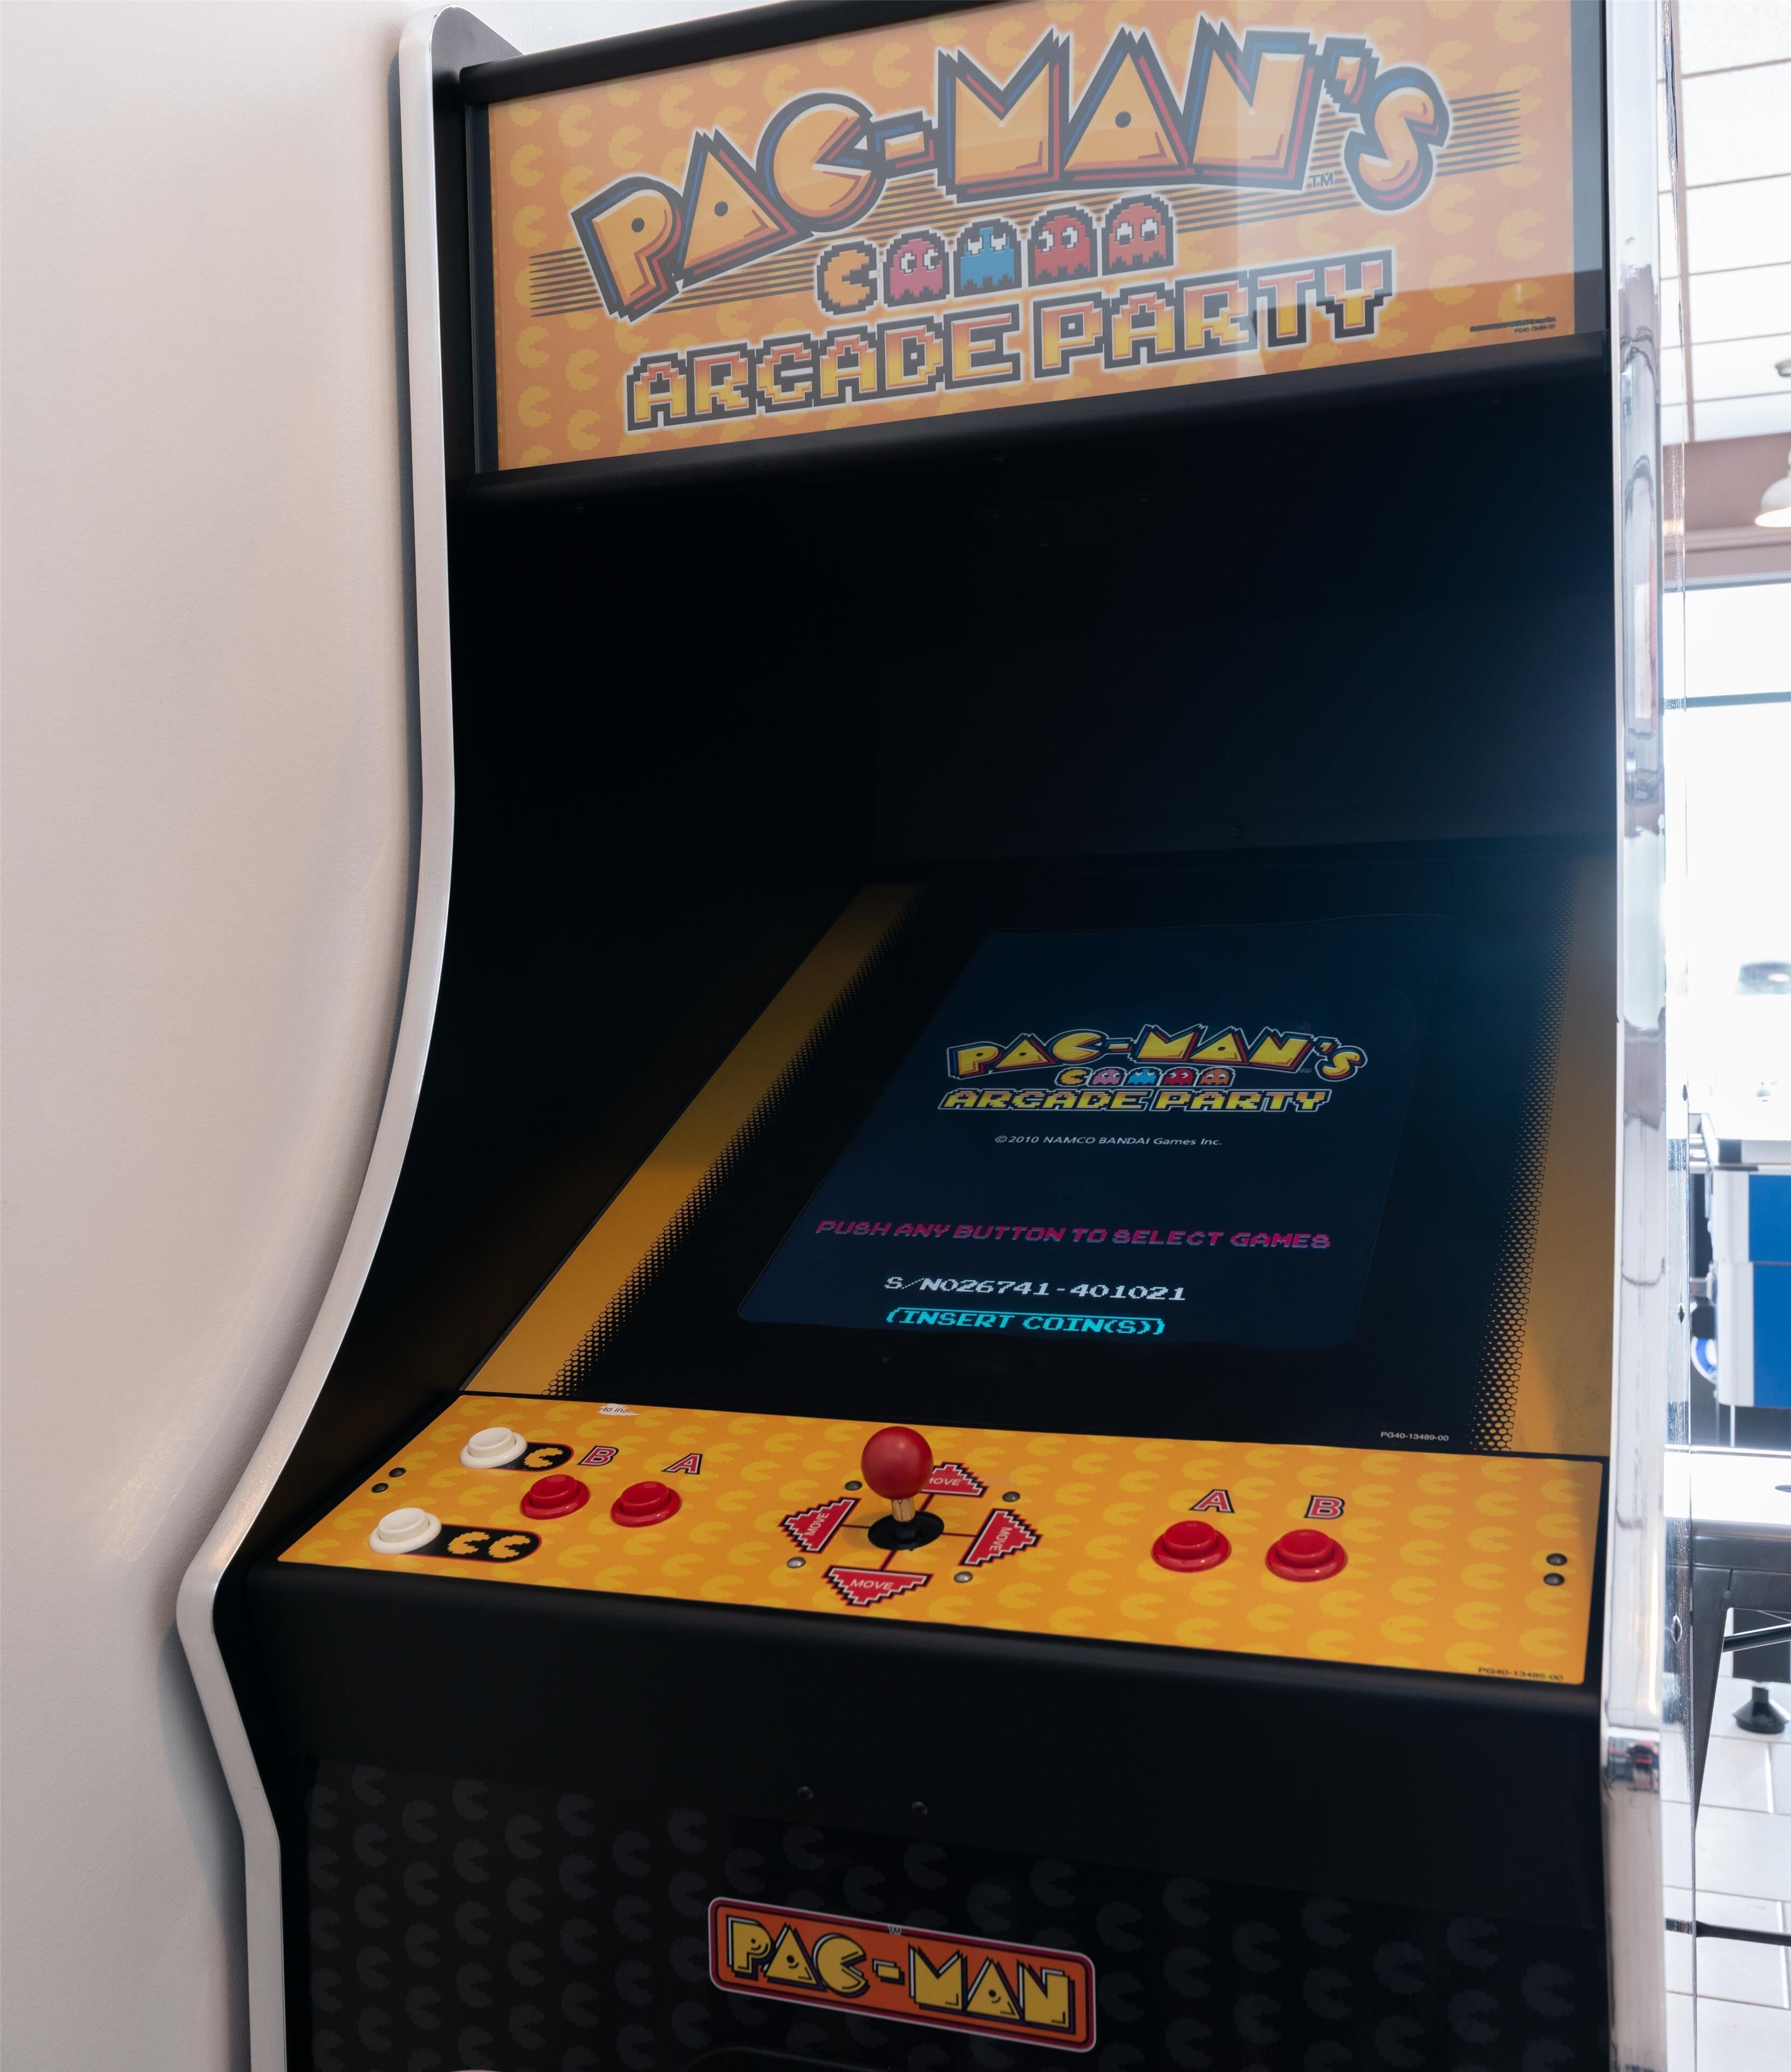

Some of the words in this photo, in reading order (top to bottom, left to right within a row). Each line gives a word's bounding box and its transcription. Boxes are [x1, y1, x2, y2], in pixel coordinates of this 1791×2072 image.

[572, 14, 1450, 322] PAC-MAN'S
[1308, 172, 1335, 188] TM
[626, 304, 1020, 431] ARCADE
[1031, 248, 1394, 378] PARTY
[946, 1024, 1368, 1081] PAC-MAN'S
[938, 1089, 1149, 1110] ARCADE
[1149, 1089, 1332, 1112] PARTY
[1043, 1136, 1096, 1144] NAMCO
[816, 1221, 893, 1237] PUSH
[893, 1223, 951, 1238] ANY
[953, 1225, 1066, 1242] BUTTON
[1072, 1228, 1108, 1243] TO
[1112, 1229, 1224, 1246] SELECT
[1231, 1232, 1331, 1249] GAMES
[1380, 1431, 1450, 1441] PG40-13489-00
[576, 1446, 619, 1466] B
[661, 1453, 703, 1475] A
[1188, 1489, 1235, 1513] A
[1304, 1495, 1345, 1519] B
[804, 1512, 830, 1537] MOVE
[989, 1526, 1013, 1552] MOVE
[850, 1579, 894, 1591] MOVE
[889, 1925, 901, 1936] TM
[726, 1915, 1077, 2035] PAC-MAN
